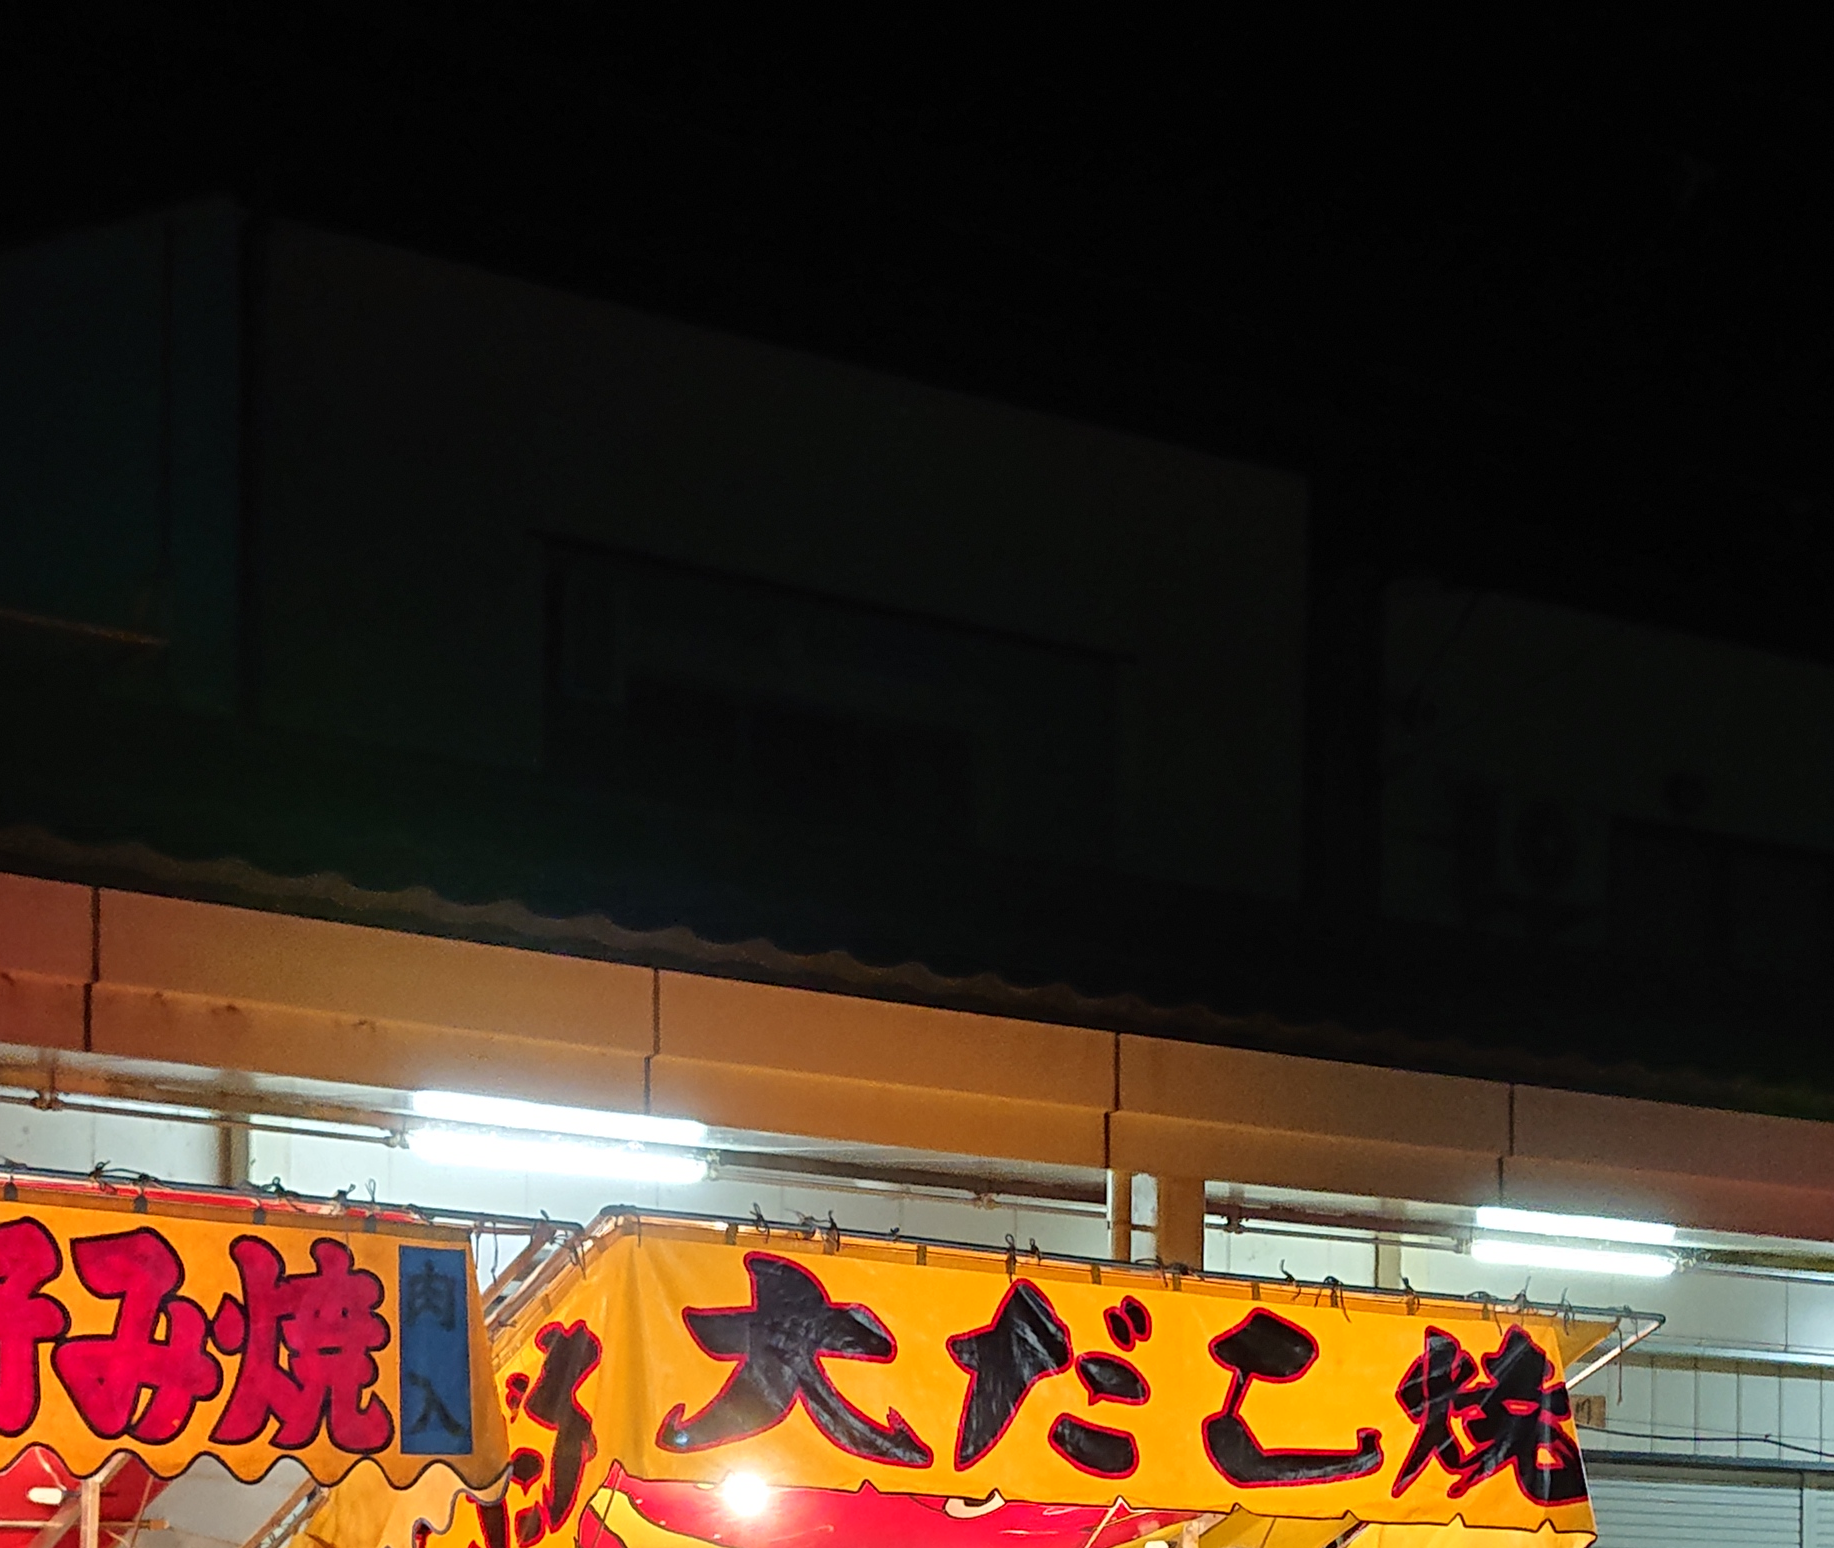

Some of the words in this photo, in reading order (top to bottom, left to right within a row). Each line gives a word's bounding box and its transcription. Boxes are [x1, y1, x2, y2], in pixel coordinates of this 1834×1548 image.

[405, 1259, 465, 1437] 肉入
[654, 1251, 1593, 1507] 大だこ焼
